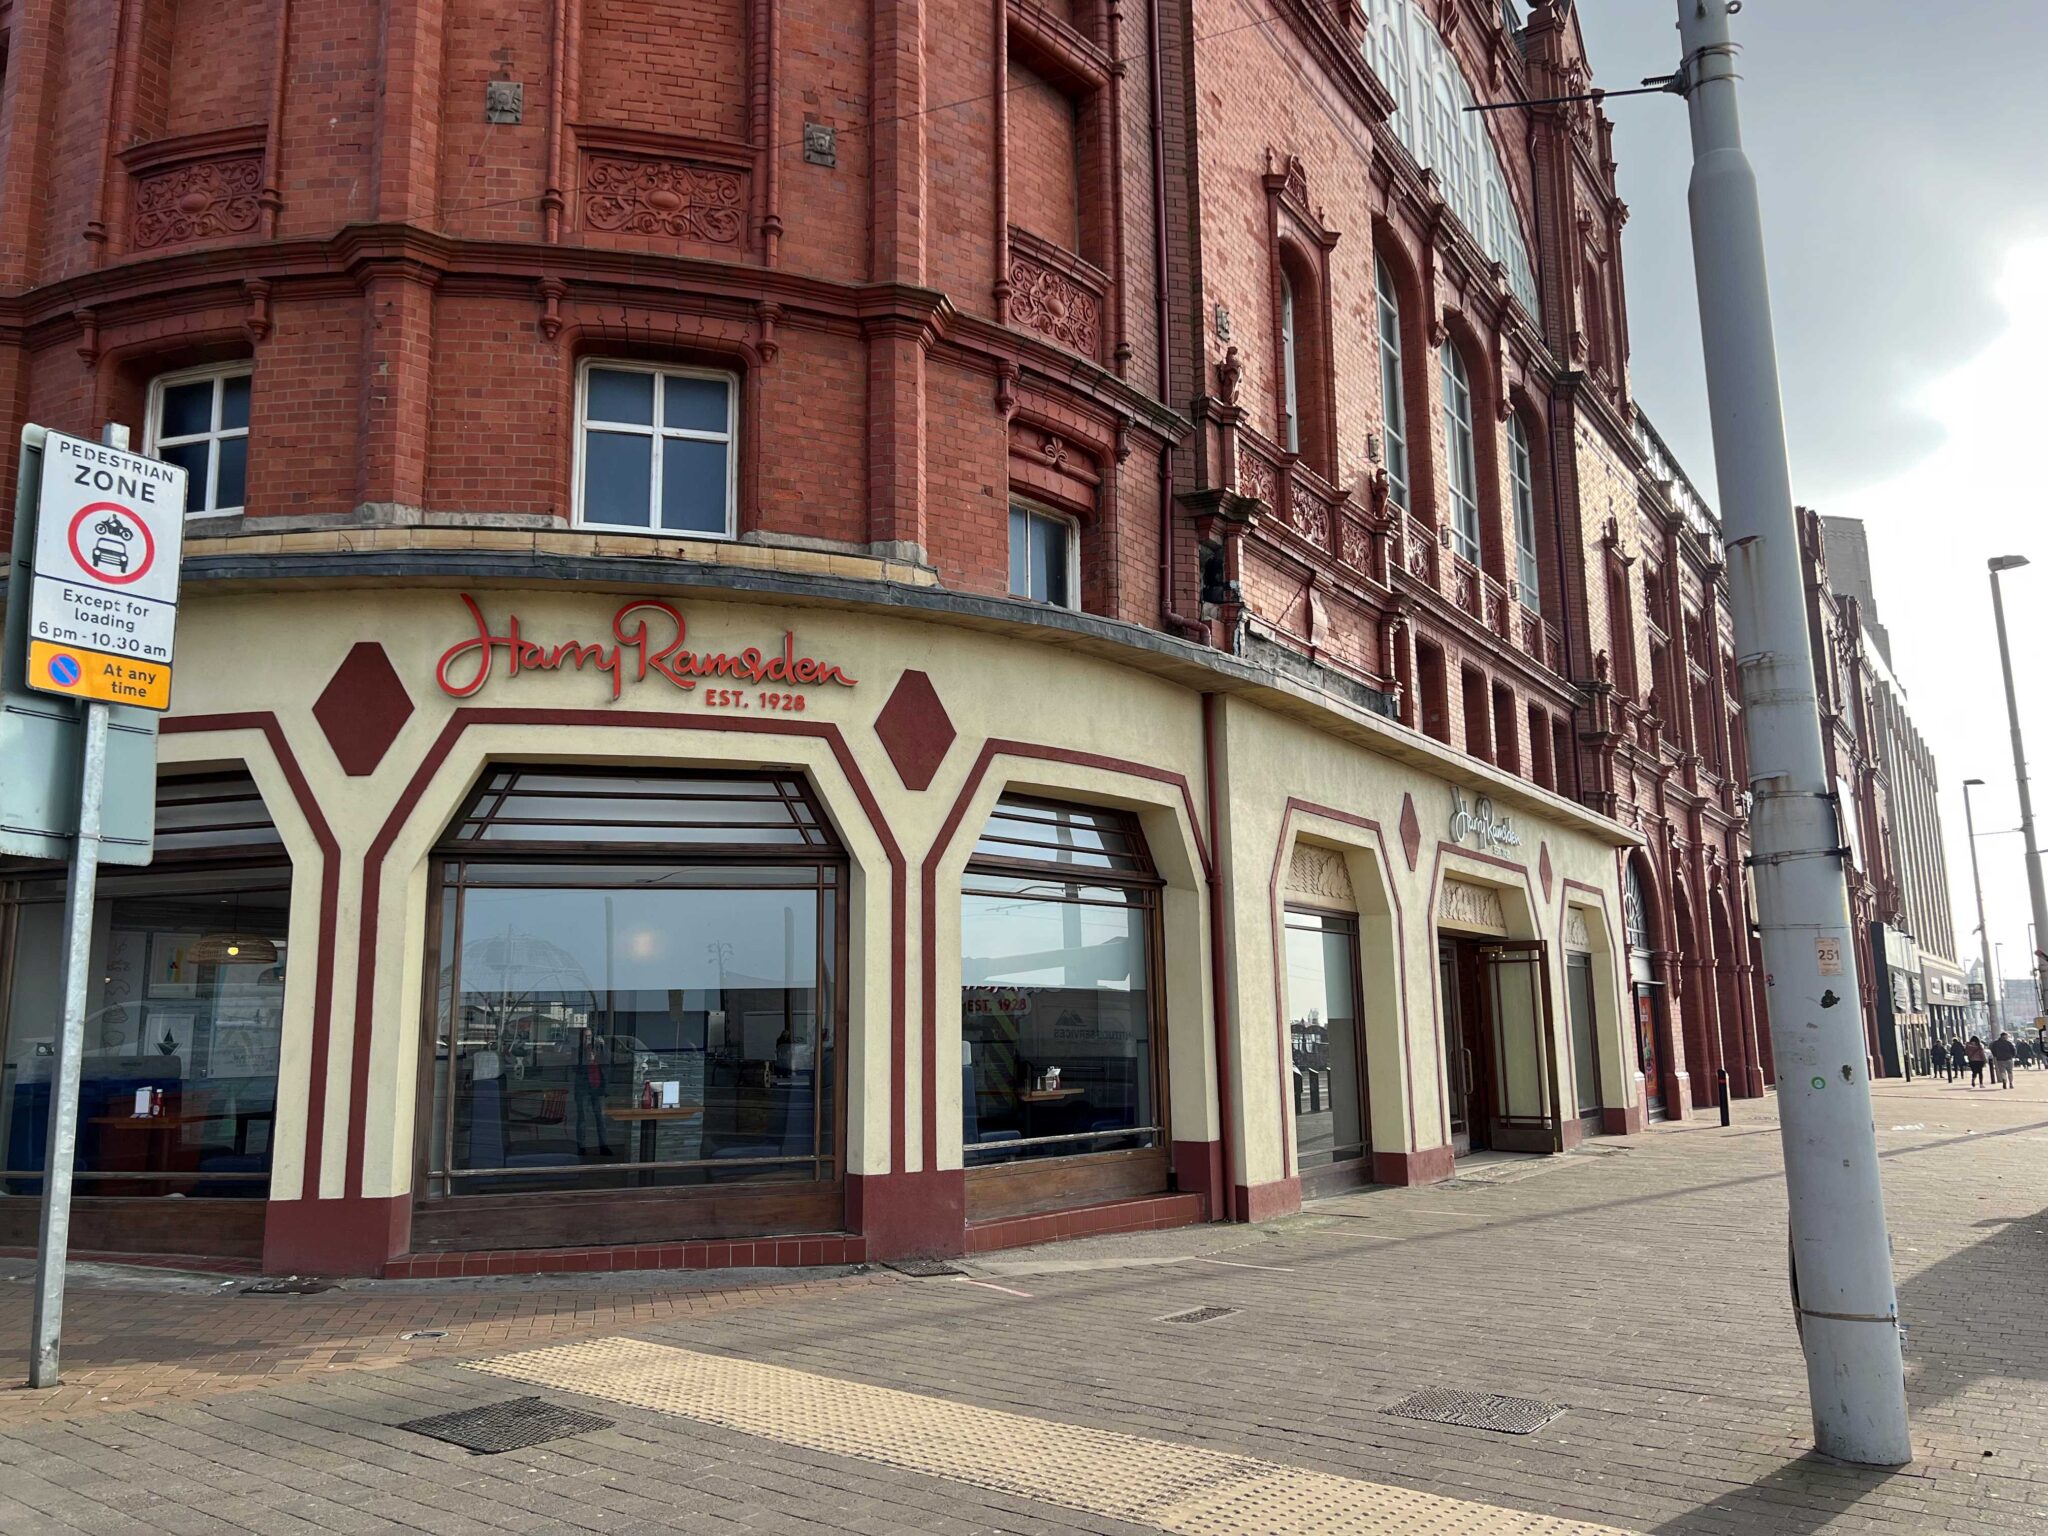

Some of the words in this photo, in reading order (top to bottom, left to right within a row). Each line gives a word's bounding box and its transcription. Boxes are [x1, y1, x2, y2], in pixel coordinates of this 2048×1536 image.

[60, 441, 174, 484] PEDESTRIAN
[75, 464, 156, 504] ZONE
[63, 588, 121, 612] Except
[127, 602, 150, 617] for
[75, 607, 135, 633] loading
[39, 621, 49, 634] 6
[53, 627, 77, 640] pm
[91, 632, 140, 652] 10.30
[143, 644, 167, 657] am
[436, 592, 621, 701] Harry
[612, 600, 859, 691] Ramsden
[103, 663, 122, 678] At
[128, 670, 157, 685] any
[111, 681, 147, 698] time
[705, 688, 749, 709] EST.
[759, 691, 806, 711] 1928
[1817, 949, 1840, 961] 251
